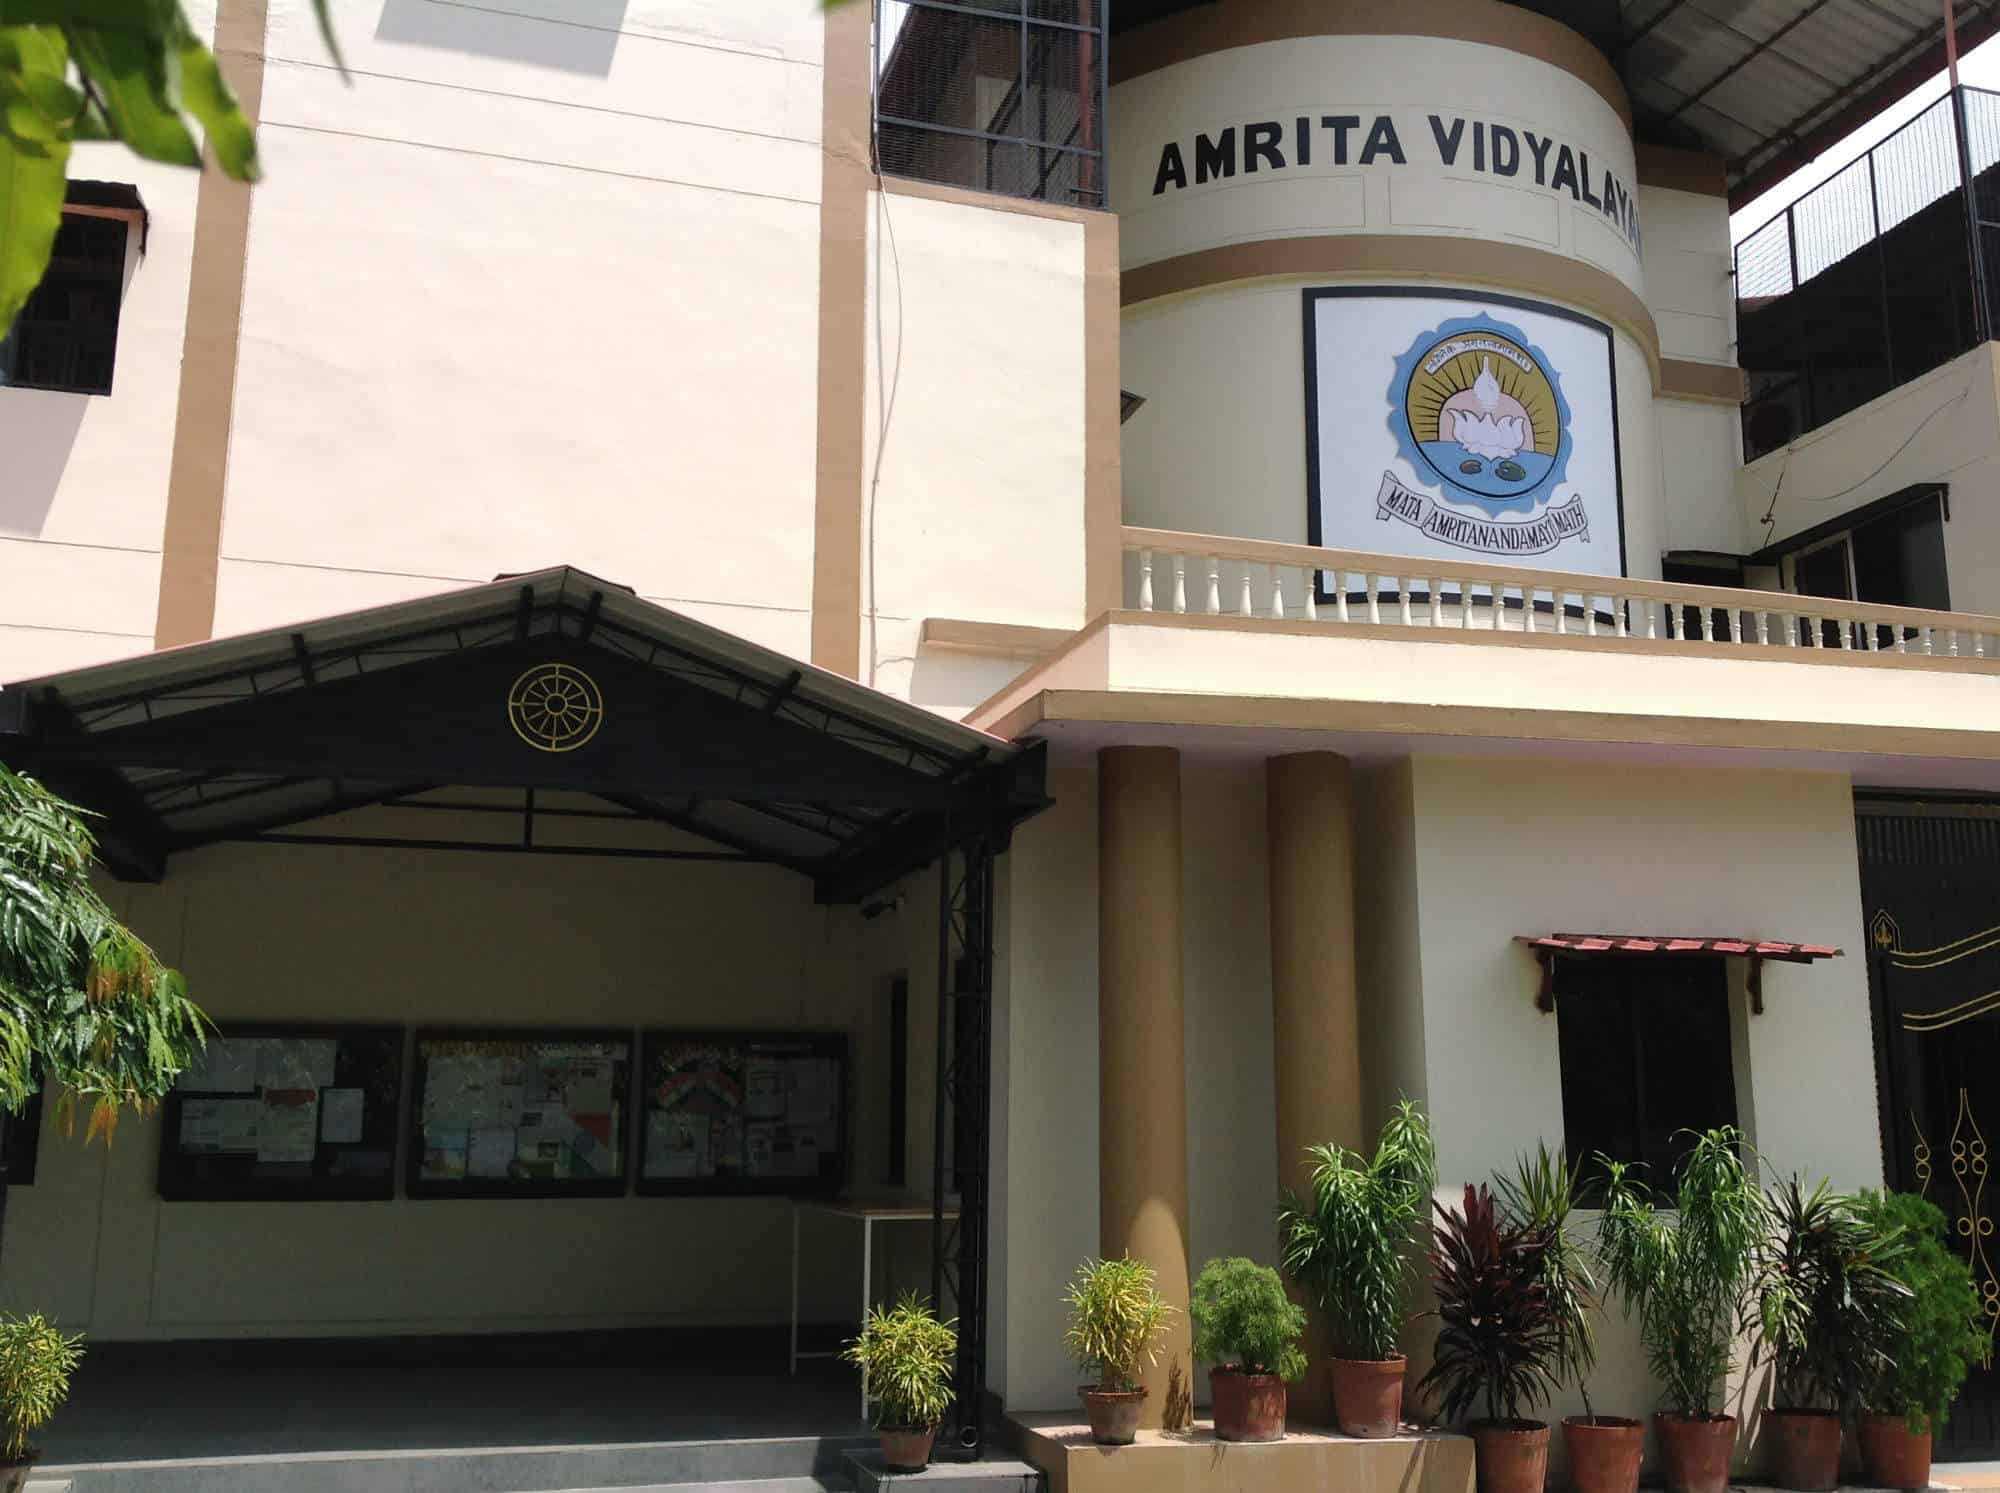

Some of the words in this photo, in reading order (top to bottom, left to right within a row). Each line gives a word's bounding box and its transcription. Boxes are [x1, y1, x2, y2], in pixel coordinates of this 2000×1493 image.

[1152, 115, 1407, 195] AMRITA
[1428, 115, 1641, 258] VIDYALAYA
[1385, 485, 1422, 521] MATA
[1423, 511, 1557, 550] AMRITANANDAMAYI
[1551, 503, 1584, 532] MATH
